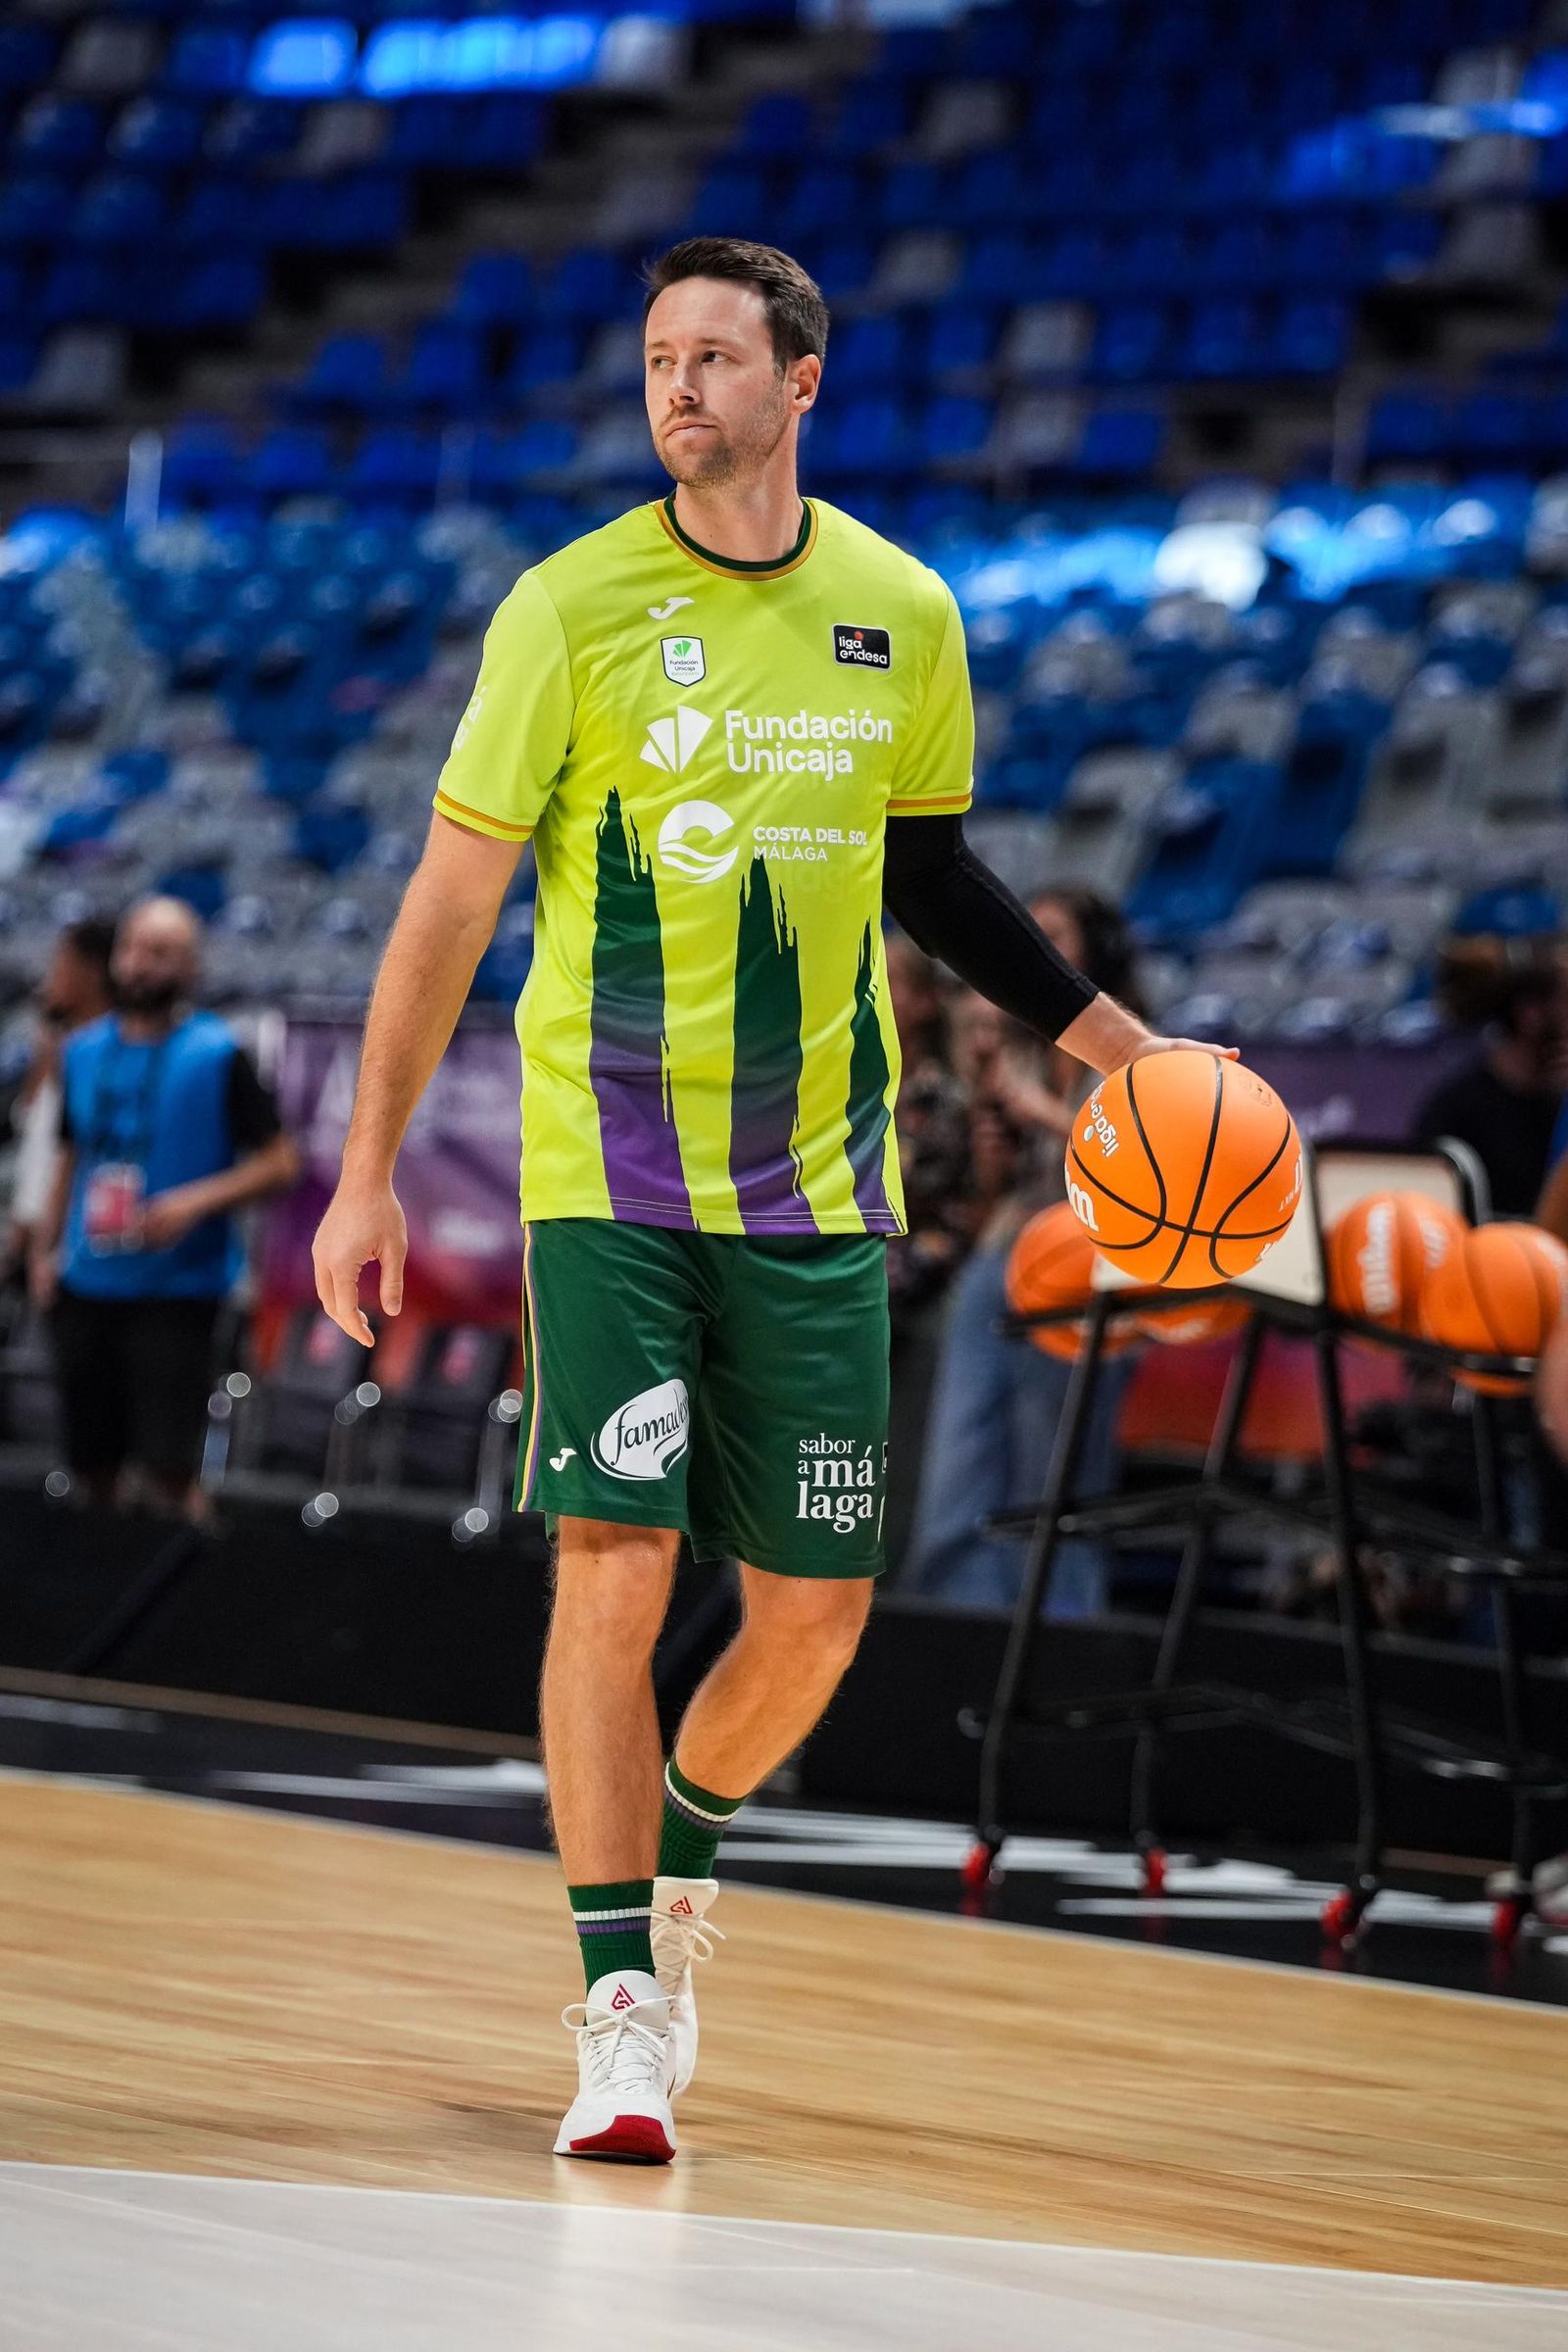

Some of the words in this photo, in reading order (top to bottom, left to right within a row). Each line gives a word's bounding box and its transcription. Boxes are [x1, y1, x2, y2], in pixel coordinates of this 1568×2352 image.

[839, 636, 862, 650] liga
[840, 649, 888, 664] endesa
[725, 710, 893, 744] Fundación
[727, 742, 854, 781] Unicaja
[753, 826, 812, 843] COSTA
[815, 828, 846, 845] DEL
[849, 830, 868, 846] SOL
[754, 842, 828, 861] MÁLAGA
[1095, 1115, 1120, 1157] liga
[799, 1433, 856, 1454] sabor
[798, 1459, 810, 1474] a
[811, 1445, 876, 1488] má
[796, 1481, 874, 1534] laga
